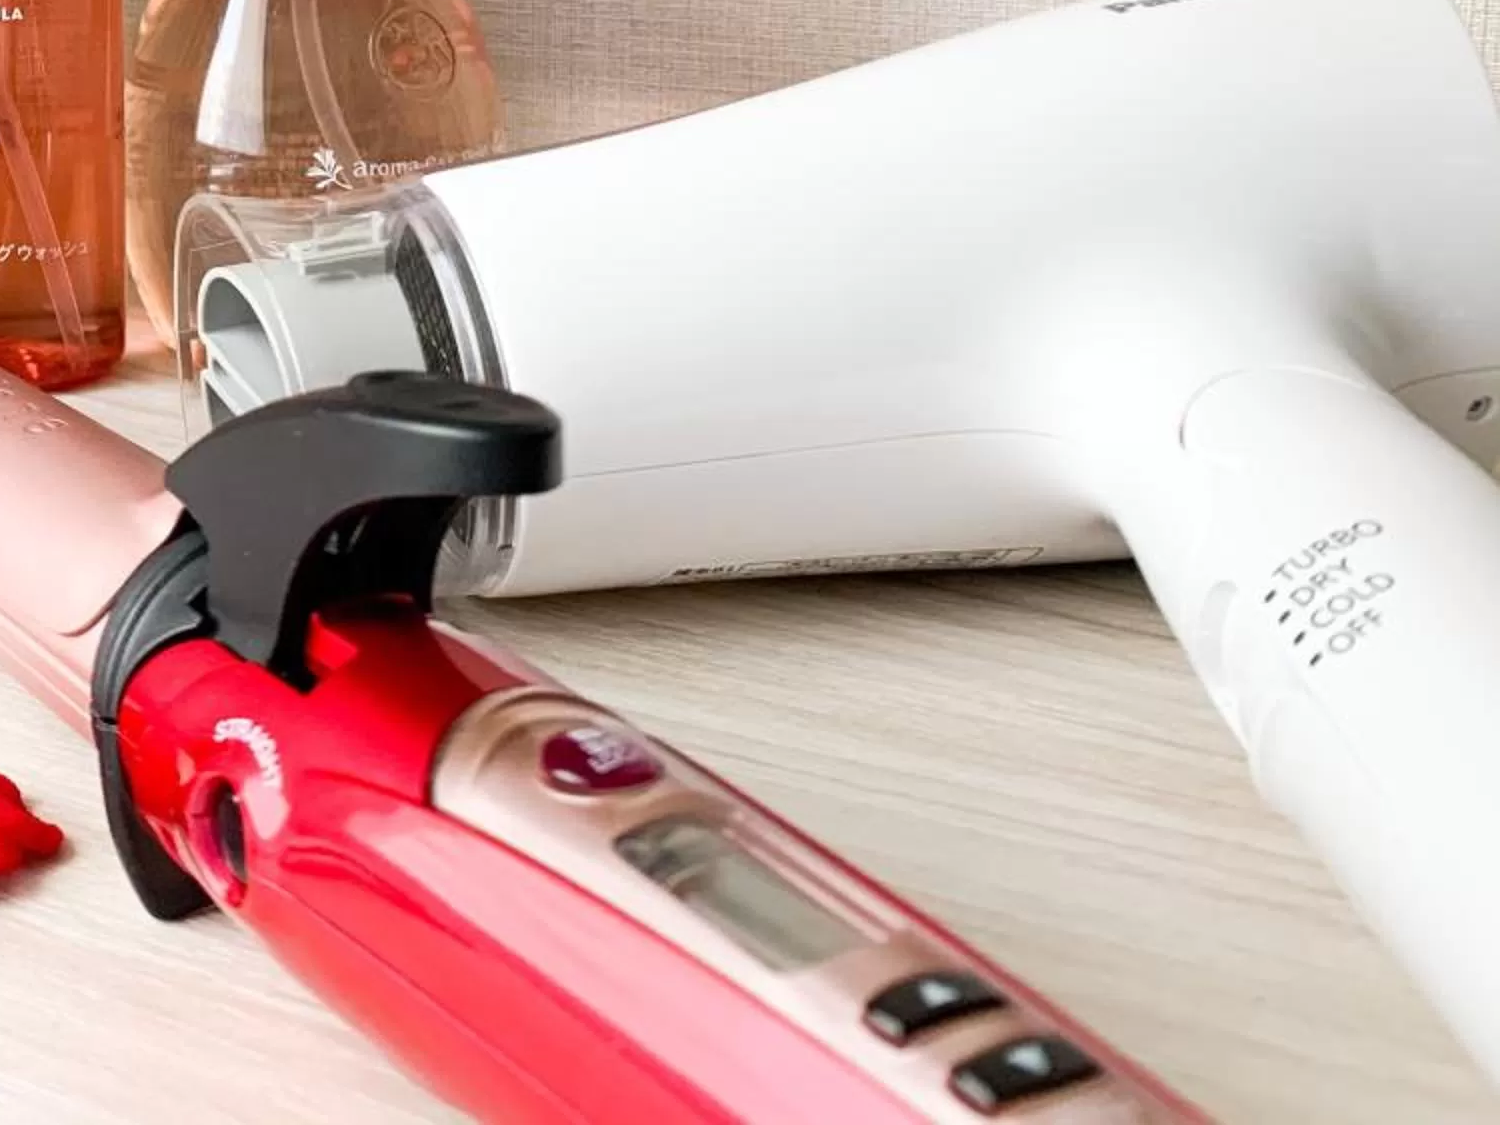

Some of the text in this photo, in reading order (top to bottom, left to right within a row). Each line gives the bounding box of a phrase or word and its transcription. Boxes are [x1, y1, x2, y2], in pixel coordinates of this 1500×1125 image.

[1271, 519, 1384, 581] TURBO
[1288, 556, 1352, 607] DRY
[1309, 572, 1396, 630] COLD
[1327, 608, 1384, 655] OFF
